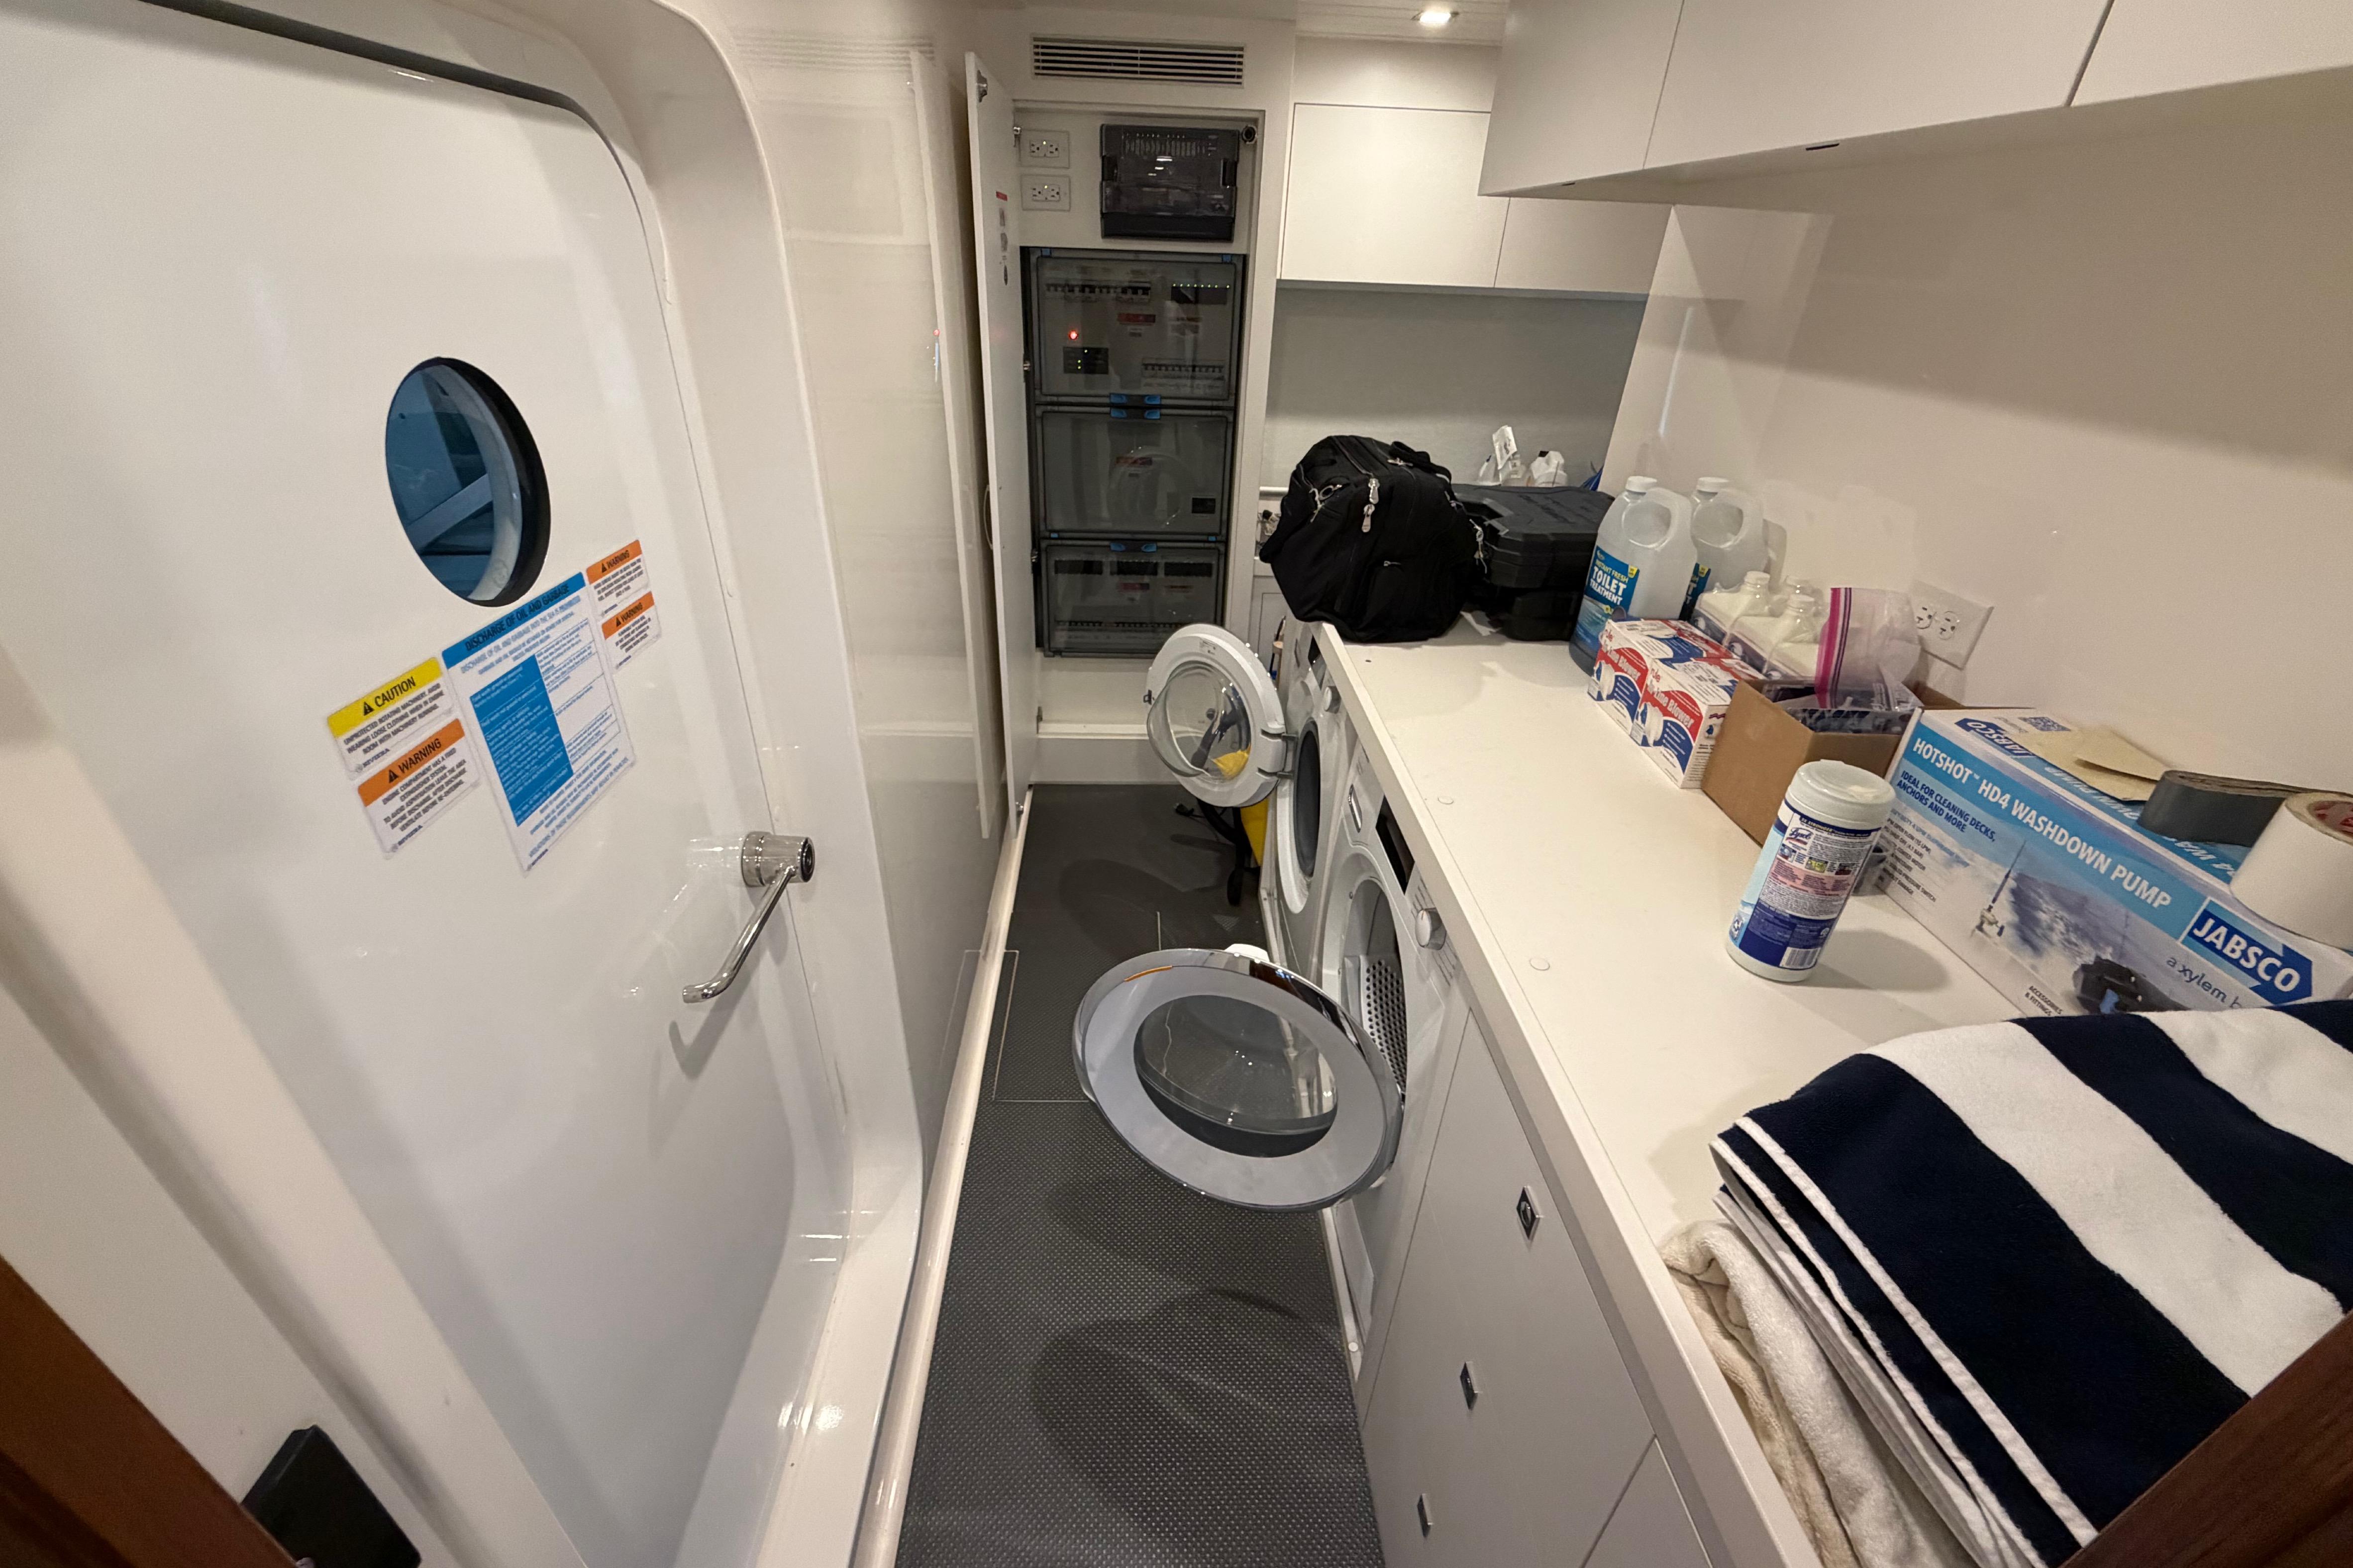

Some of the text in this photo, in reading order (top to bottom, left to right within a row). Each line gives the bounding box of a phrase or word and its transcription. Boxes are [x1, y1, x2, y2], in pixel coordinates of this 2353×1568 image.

[606, 549, 630, 569] WARNING
[1596, 559, 1612, 574] INSTANT
[1612, 570, 1629, 584] FRESH
[1590, 579, 1623, 605] TREATMENT
[1593, 566, 1627, 596] TOILET
[464, 620, 507, 653] DISCHARGE
[505, 614, 517, 628] OF
[516, 607, 528, 621] OIL
[527, 598, 543, 615] AND
[620, 601, 643, 622] WARNING
[1618, 656, 1641, 681] Blower
[373, 676, 416, 708] CAUTION
[343, 720, 379, 745] UNPROTECTED
[378, 706, 401, 724] ROTATING
[346, 735, 371, 754] WEARING
[370, 725, 387, 739] LOOSE
[386, 711, 409, 729] CLOTHING
[408, 702, 423, 715] WHEN
[1668, 699, 1695, 729] Blower
[362, 741, 378, 755] ROOM
[378, 732, 392, 745] WITH
[391, 716, 418, 736] MACHINERY
[1966, 721, 2034, 756] JABSCO
[398, 737, 442, 775] WARNING
[1897, 780, 1967, 833] ANCHORS AND MORE
[1901, 771, 1920, 789] IDEAL
[1920, 784, 1935, 798] FOR
[1935, 793, 1970, 822] CLEANING
[1969, 817, 1996, 842] DECKS,
[1978, 779, 2011, 809] HD4
[2011, 799, 2112, 875] WASHDOWN
[2111, 864, 2172, 909] PUMP
[2193, 918, 2301, 992] JABSCO
[2166, 957, 2177, 968] a
[2177, 964, 2227, 1003] xylem
[2029, 985, 2063, 1014] ACCESSORIES
[2030, 995, 2052, 1016] FITTINGS
